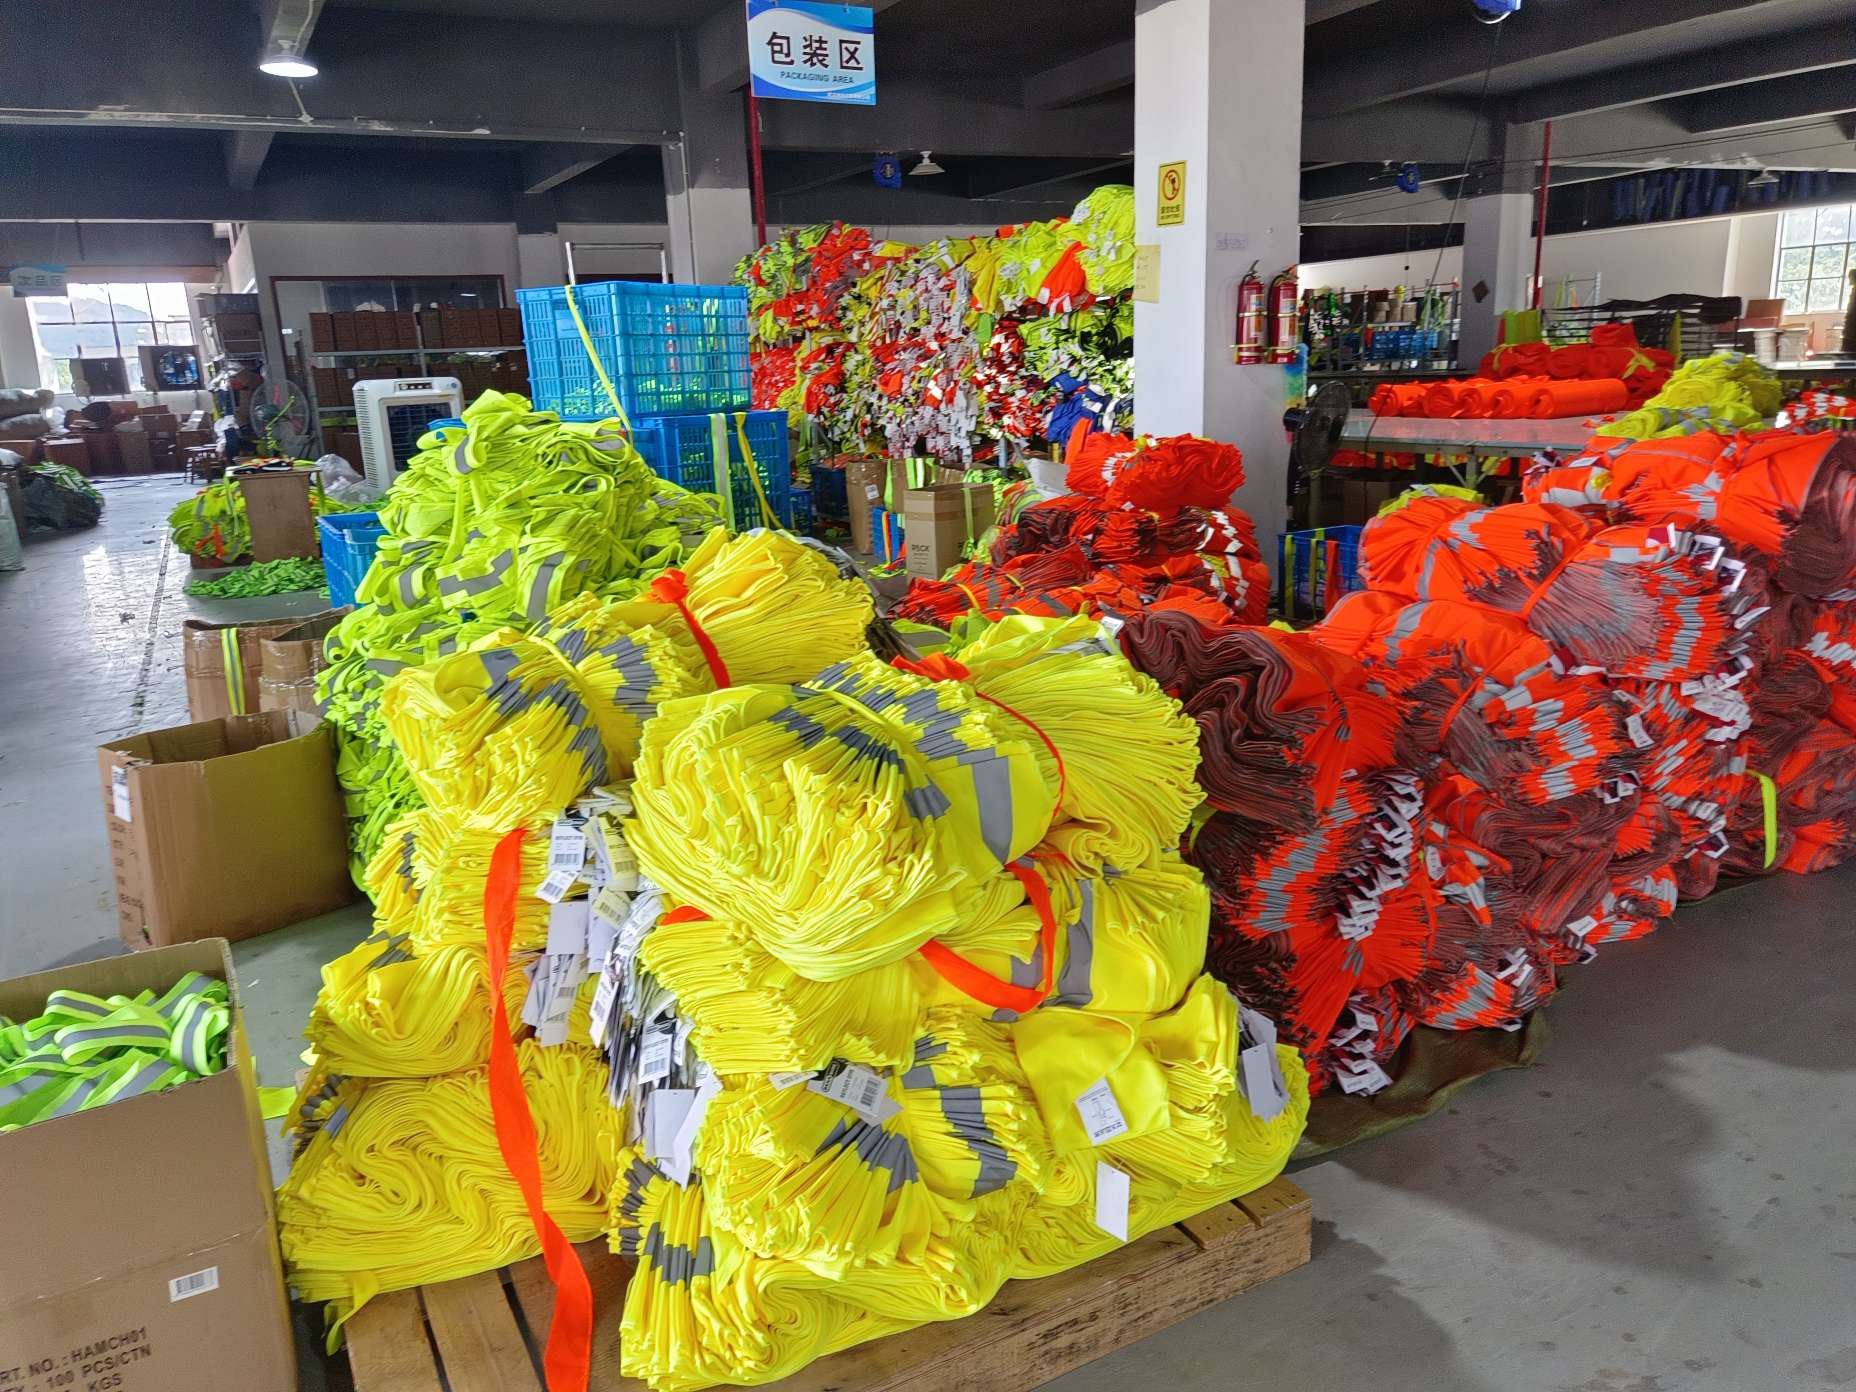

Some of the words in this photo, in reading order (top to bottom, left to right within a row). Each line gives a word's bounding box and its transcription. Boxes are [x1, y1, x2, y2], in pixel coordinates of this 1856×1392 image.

[766, 31, 864, 71] 包装区
[780, 71, 829, 83] PACKAGING
[832, 75, 855, 85] AREA
